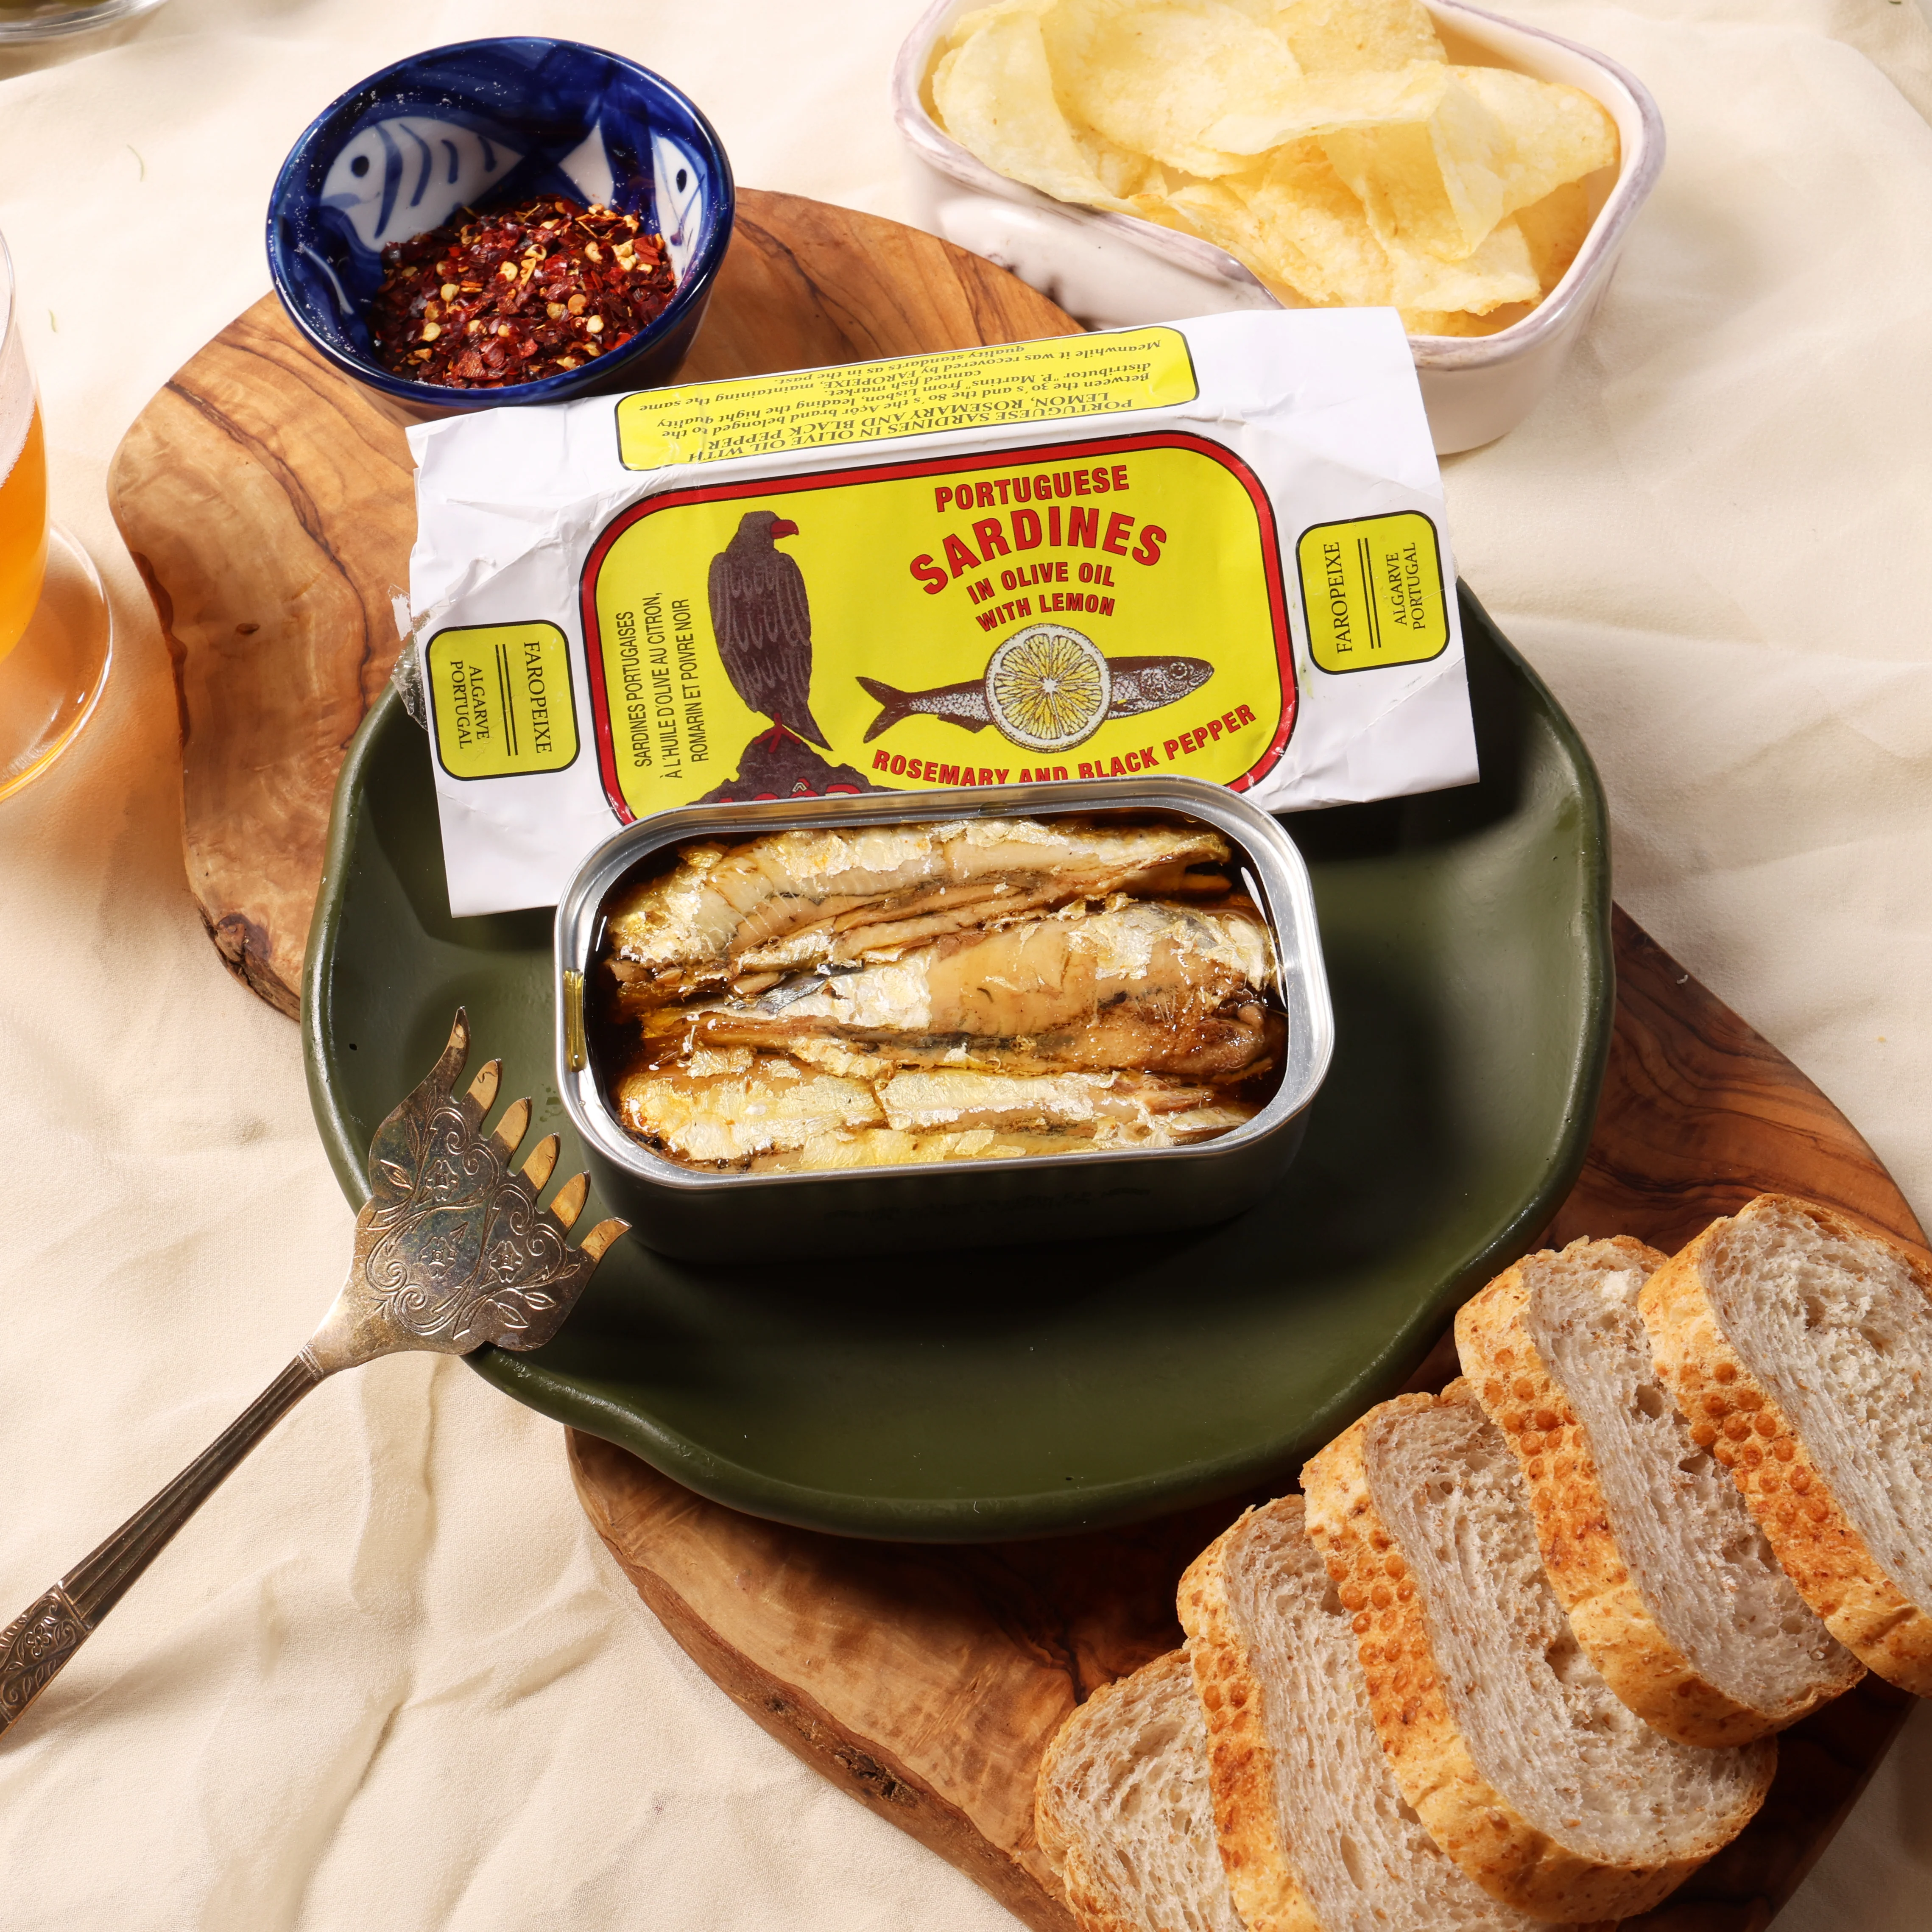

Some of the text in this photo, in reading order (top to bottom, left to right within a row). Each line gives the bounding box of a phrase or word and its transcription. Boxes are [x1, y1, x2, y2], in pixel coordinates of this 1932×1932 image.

[968, 345, 1025, 358] quality
[1058, 351, 1070, 360] it
[1075, 340, 1160, 359] Meanwhile
[888, 354, 964, 371] standarts
[921, 366, 938, 374] by
[943, 356, 1019, 372] recovered
[1063, 362, 1151, 378] distributor
[774, 373, 812, 384] past.
[817, 371, 842, 380] the
[820, 370, 916, 388] FAROPEIXE,
[824, 370, 981, 396] canned fish market.
[1083, 372, 1149, 387] Between
[715, 383, 814, 402] maintaining
[922, 379, 963, 392] from
[982, 387, 1012, 398] and
[1053, 382, 1078, 391] the
[685, 397, 710, 406] the
[796, 397, 855, 409] leading
[861, 388, 917, 402] Lisbon,
[951, 391, 977, 399] the
[639, 400, 681, 411] same
[765, 405, 790, 414] the
[841, 404, 879, 415] Açôr
[883, 399, 908, 409] the
[656, 416, 714, 429] quality
[707, 392, 1108, 450] LEMON, ROSEMARY AND BLACK PEPPER
[718, 409, 760, 423] hight
[790, 409, 837, 423] brand
[662, 429, 687, 439] the
[687, 399, 1132, 462] PORTUGUESE SARDINES IN OLIVE OIL WITH
[692, 427, 708, 435] to
[712, 416, 785, 436] belonged
[935, 465, 1129, 512] PORTUGUESE
[910, 506, 1167, 595] SARDINES
[966, 562, 1115, 605] IN OLIVE OIL
[1386, 552, 1407, 626] ALGARVE
[1403, 542, 1426, 631] PORTUGAL
[1323, 542, 1352, 654] FAROPEIXE
[642, 592, 664, 645] CITRON,
[975, 593, 1115, 632] WITH LEMON
[650, 648, 668, 665] AU
[671, 598, 709, 762] ROMARIN ET POIVRE NOIR
[616, 611, 652, 767] SARDINES PORTUGAISES
[450, 660, 472, 749] PORTUGAL
[469, 665, 490, 740] ALGARVE
[524, 641, 552, 754] FAROPEIXE
[872, 704, 1256, 786] ROSEMARY AND BLACK PEPPER
[660, 769, 683, 779] À
